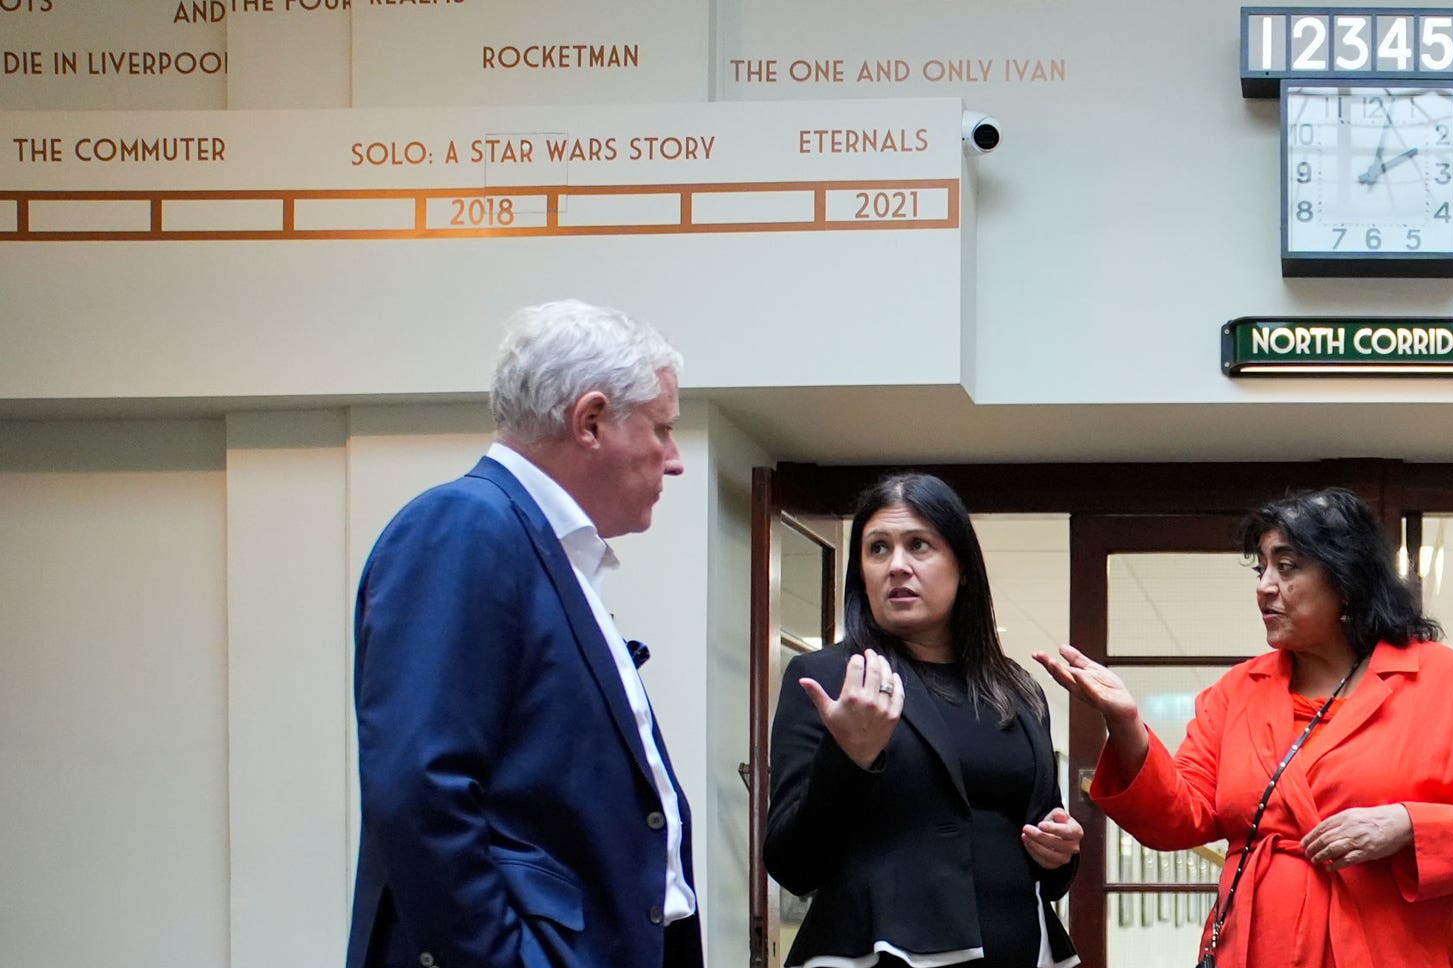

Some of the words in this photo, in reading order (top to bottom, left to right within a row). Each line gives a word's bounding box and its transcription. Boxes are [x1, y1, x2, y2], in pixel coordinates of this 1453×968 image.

[173, 0, 226, 24] AND
[3, 51, 43, 75] DIE
[53, 51, 77, 75] IN
[482, 44, 639, 69] ROCKETMAN
[729, 59, 778, 83] THE
[789, 59, 844, 83] ONE
[856, 59, 910, 83] AND
[922, 59, 993, 82] ONLY
[1005, 59, 1067, 82] IVAN
[1362, 96, 1384, 119] 12
[799, 128, 928, 154] ETERNALS
[1435, 123, 1451, 146] 2
[12, 138, 63, 163] THE
[74, 137, 225, 162] COMMUTER
[351, 140, 433, 166] SOLO:
[445, 140, 459, 164] A
[471, 138, 533, 163] STAR
[545, 137, 617, 162] WARS
[629, 135, 716, 161] STORY
[1296, 161, 1312, 184] 9
[1434, 162, 1452, 185] 3
[449, 198, 516, 227] 2018
[854, 191, 920, 220] 2021
[1296, 200, 1314, 223] 8
[1433, 201, 1452, 224] 4
[1331, 228, 1348, 251] 7
[1365, 228, 1382, 251] 6
[1405, 229, 1422, 251] 5
[1251, 326, 1345, 355] NORTH
